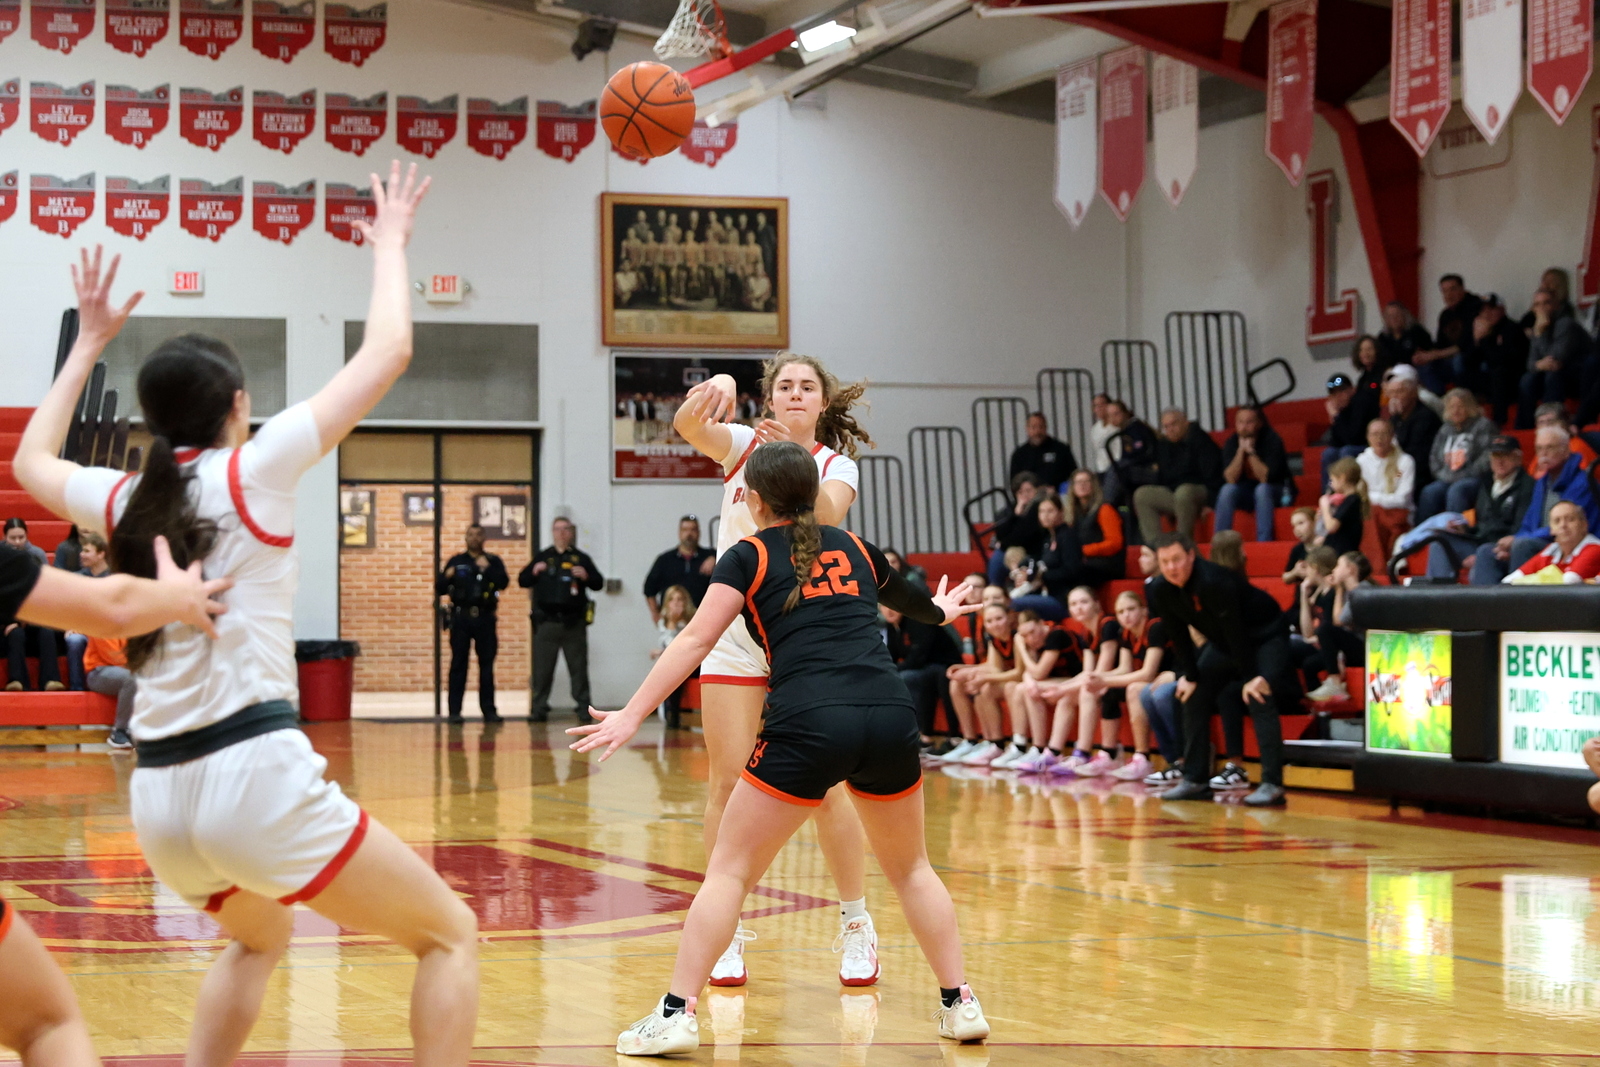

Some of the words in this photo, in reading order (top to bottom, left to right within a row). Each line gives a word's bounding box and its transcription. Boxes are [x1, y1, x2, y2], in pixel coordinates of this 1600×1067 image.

[51, 104, 74, 115] LEVI
[198, 110, 225, 120] MATT
[38, 114, 87, 125] SPURLOCK
[262, 112, 306, 123] ANTHONY
[262, 122, 306, 133] COLEMAN
[48, 197, 76, 207] MATT
[123, 199, 151, 209] MATT
[197, 201, 224, 211] MATT
[38, 206, 86, 217] ROWLAND
[113, 208, 161, 219] ROWLAND
[268, 205, 298, 214] WYATT
[188, 210, 234, 222] ROWLAND
[1306, 168, 1358, 346] L
[175, 271, 199, 290] EXIT
[432, 275, 458, 293] EXIT
[790, 550, 860, 599] 22
